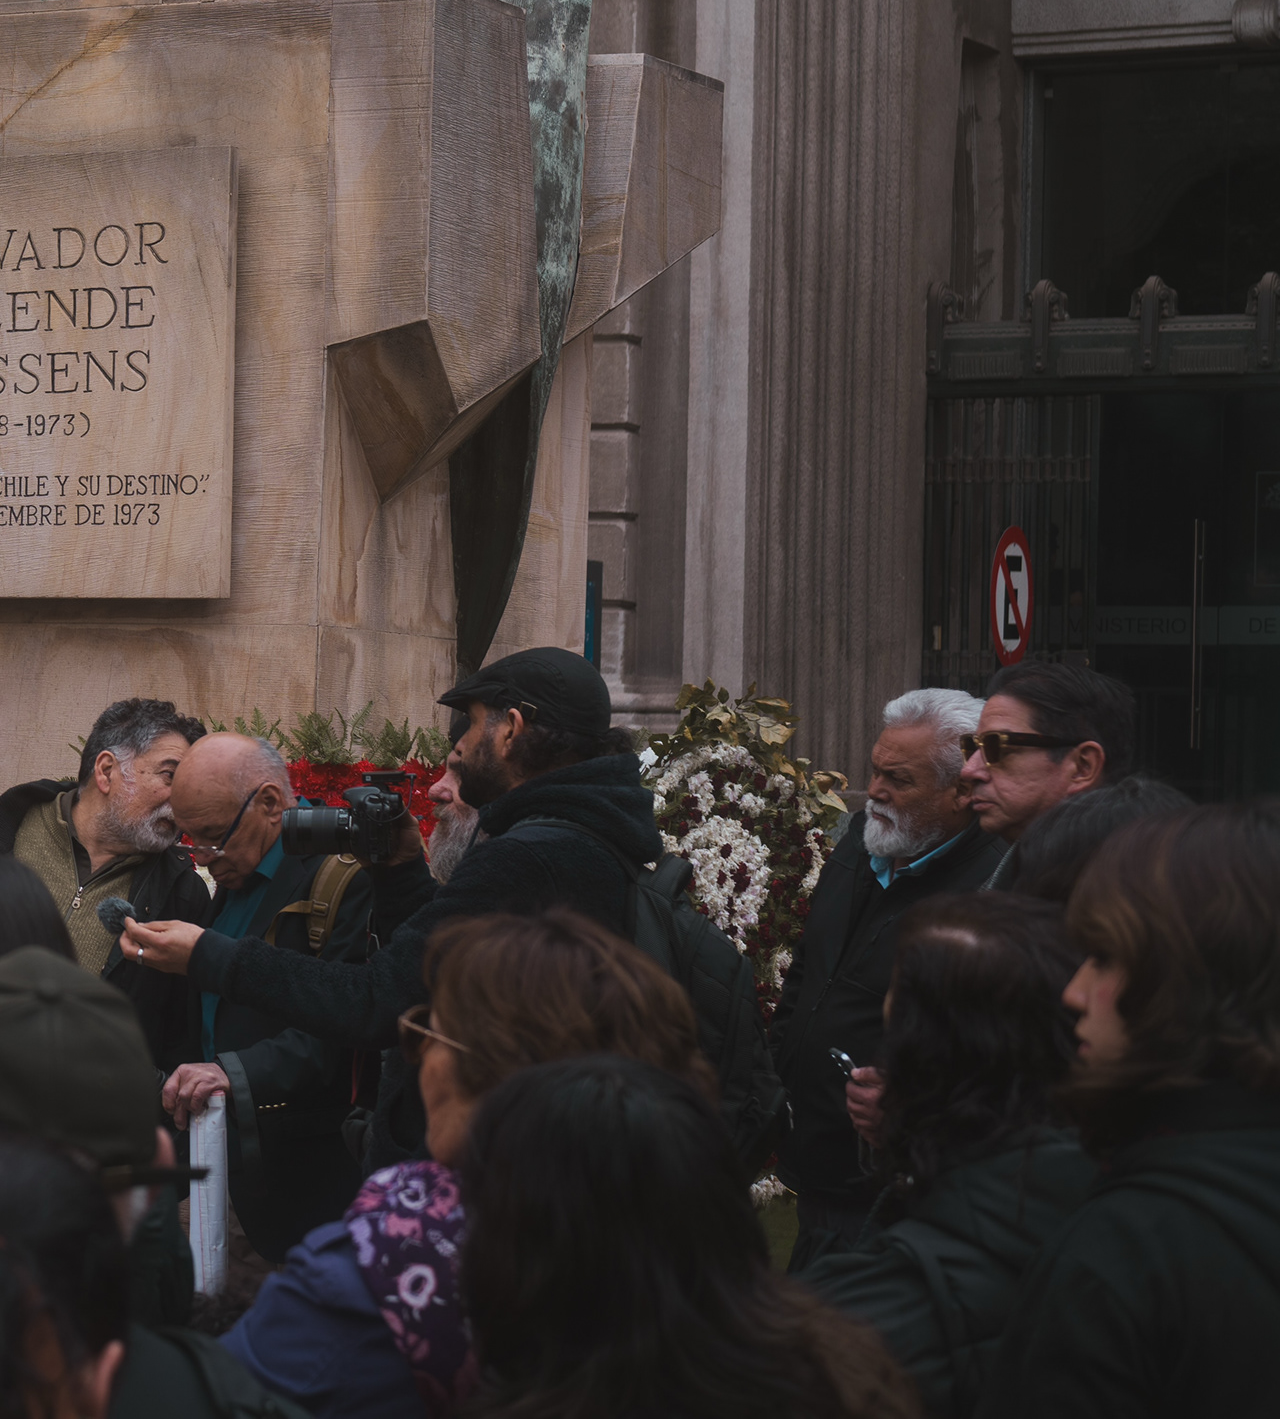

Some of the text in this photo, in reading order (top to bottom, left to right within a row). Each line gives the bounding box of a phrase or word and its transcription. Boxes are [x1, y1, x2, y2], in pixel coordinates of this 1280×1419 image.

[55, 475, 70, 497] Y
[76, 475, 101, 497] SU
[74, 504, 105, 526] DE
[112, 503, 161, 526] 1973
